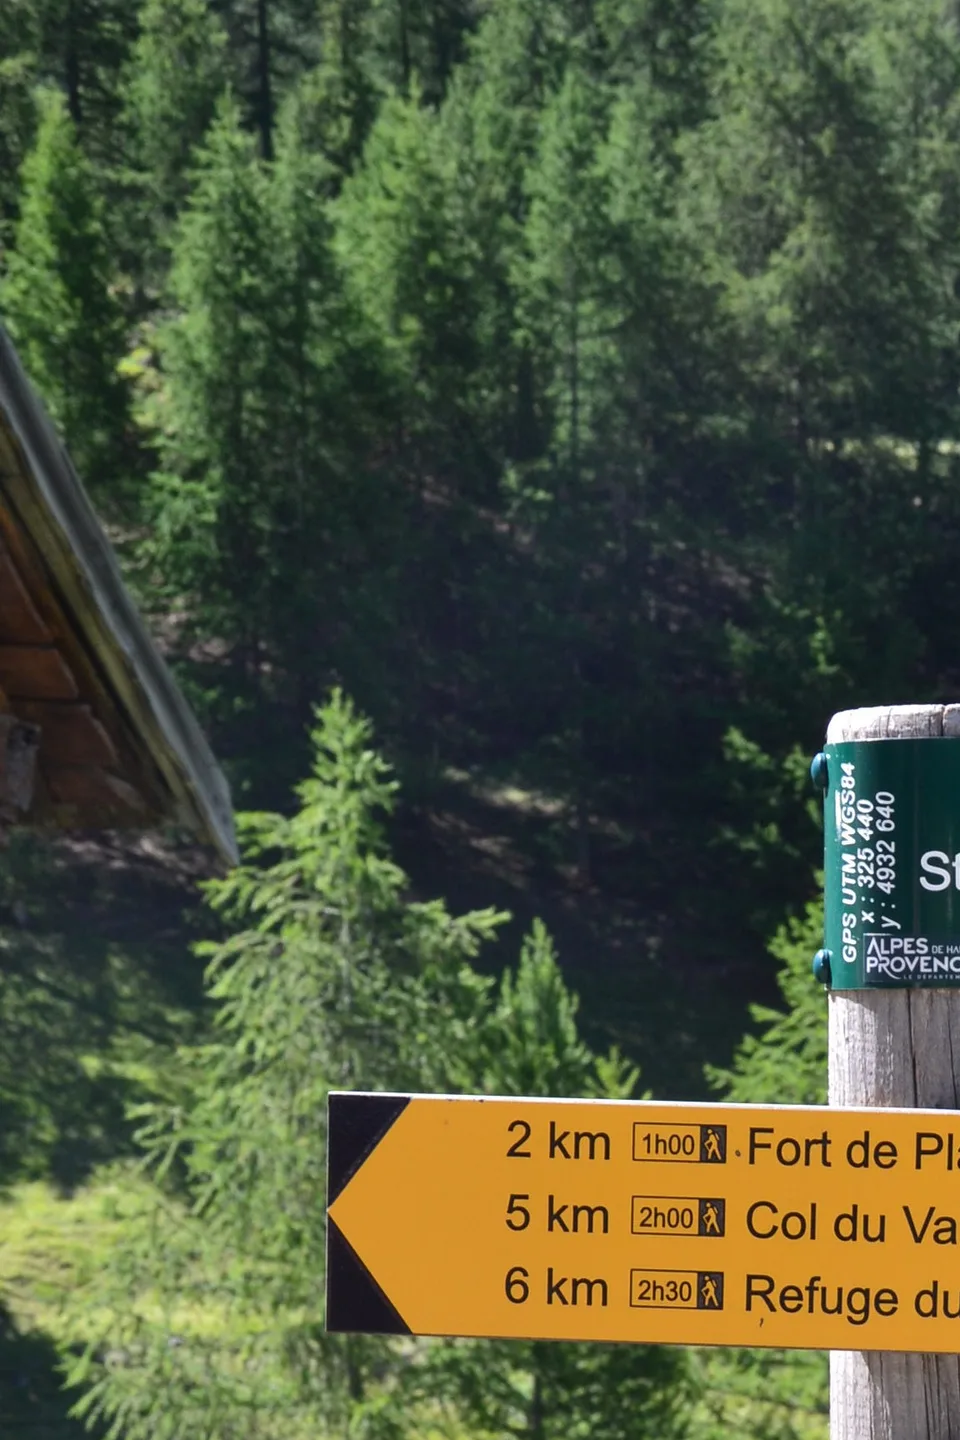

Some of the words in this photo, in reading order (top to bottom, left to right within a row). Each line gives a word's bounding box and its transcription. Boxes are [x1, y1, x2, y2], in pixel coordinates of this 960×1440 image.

[840, 762, 858, 845] WGS84
[857, 799, 875, 842] 440
[875, 791, 896, 832] 640
[841, 852, 857, 905] UTM
[857, 847, 876, 889] 325
[875, 839, 896, 893] 4932
[841, 912, 857, 963] GPS
[861, 910, 875, 924] x
[881, 915, 902, 930] y
[866, 936, 928, 956] ALPES
[931, 944, 944, 955] DE
[506, 1119, 532, 1158] 2
[548, 1120, 611, 1161] km
[642, 1133, 695, 1156] 1h00
[748, 1127, 832, 1168] Fort
[846, 1130, 898, 1170] de
[505, 1193, 531, 1232] 5
[547, 1194, 609, 1234] km
[639, 1206, 694, 1229] 2h00
[746, 1200, 817, 1241] Col
[833, 1203, 886, 1243] du
[505, 1266, 530, 1304] 6
[546, 1267, 608, 1307] km
[637, 1279, 692, 1302] 2h30
[745, 1274, 899, 1326] Refuge
